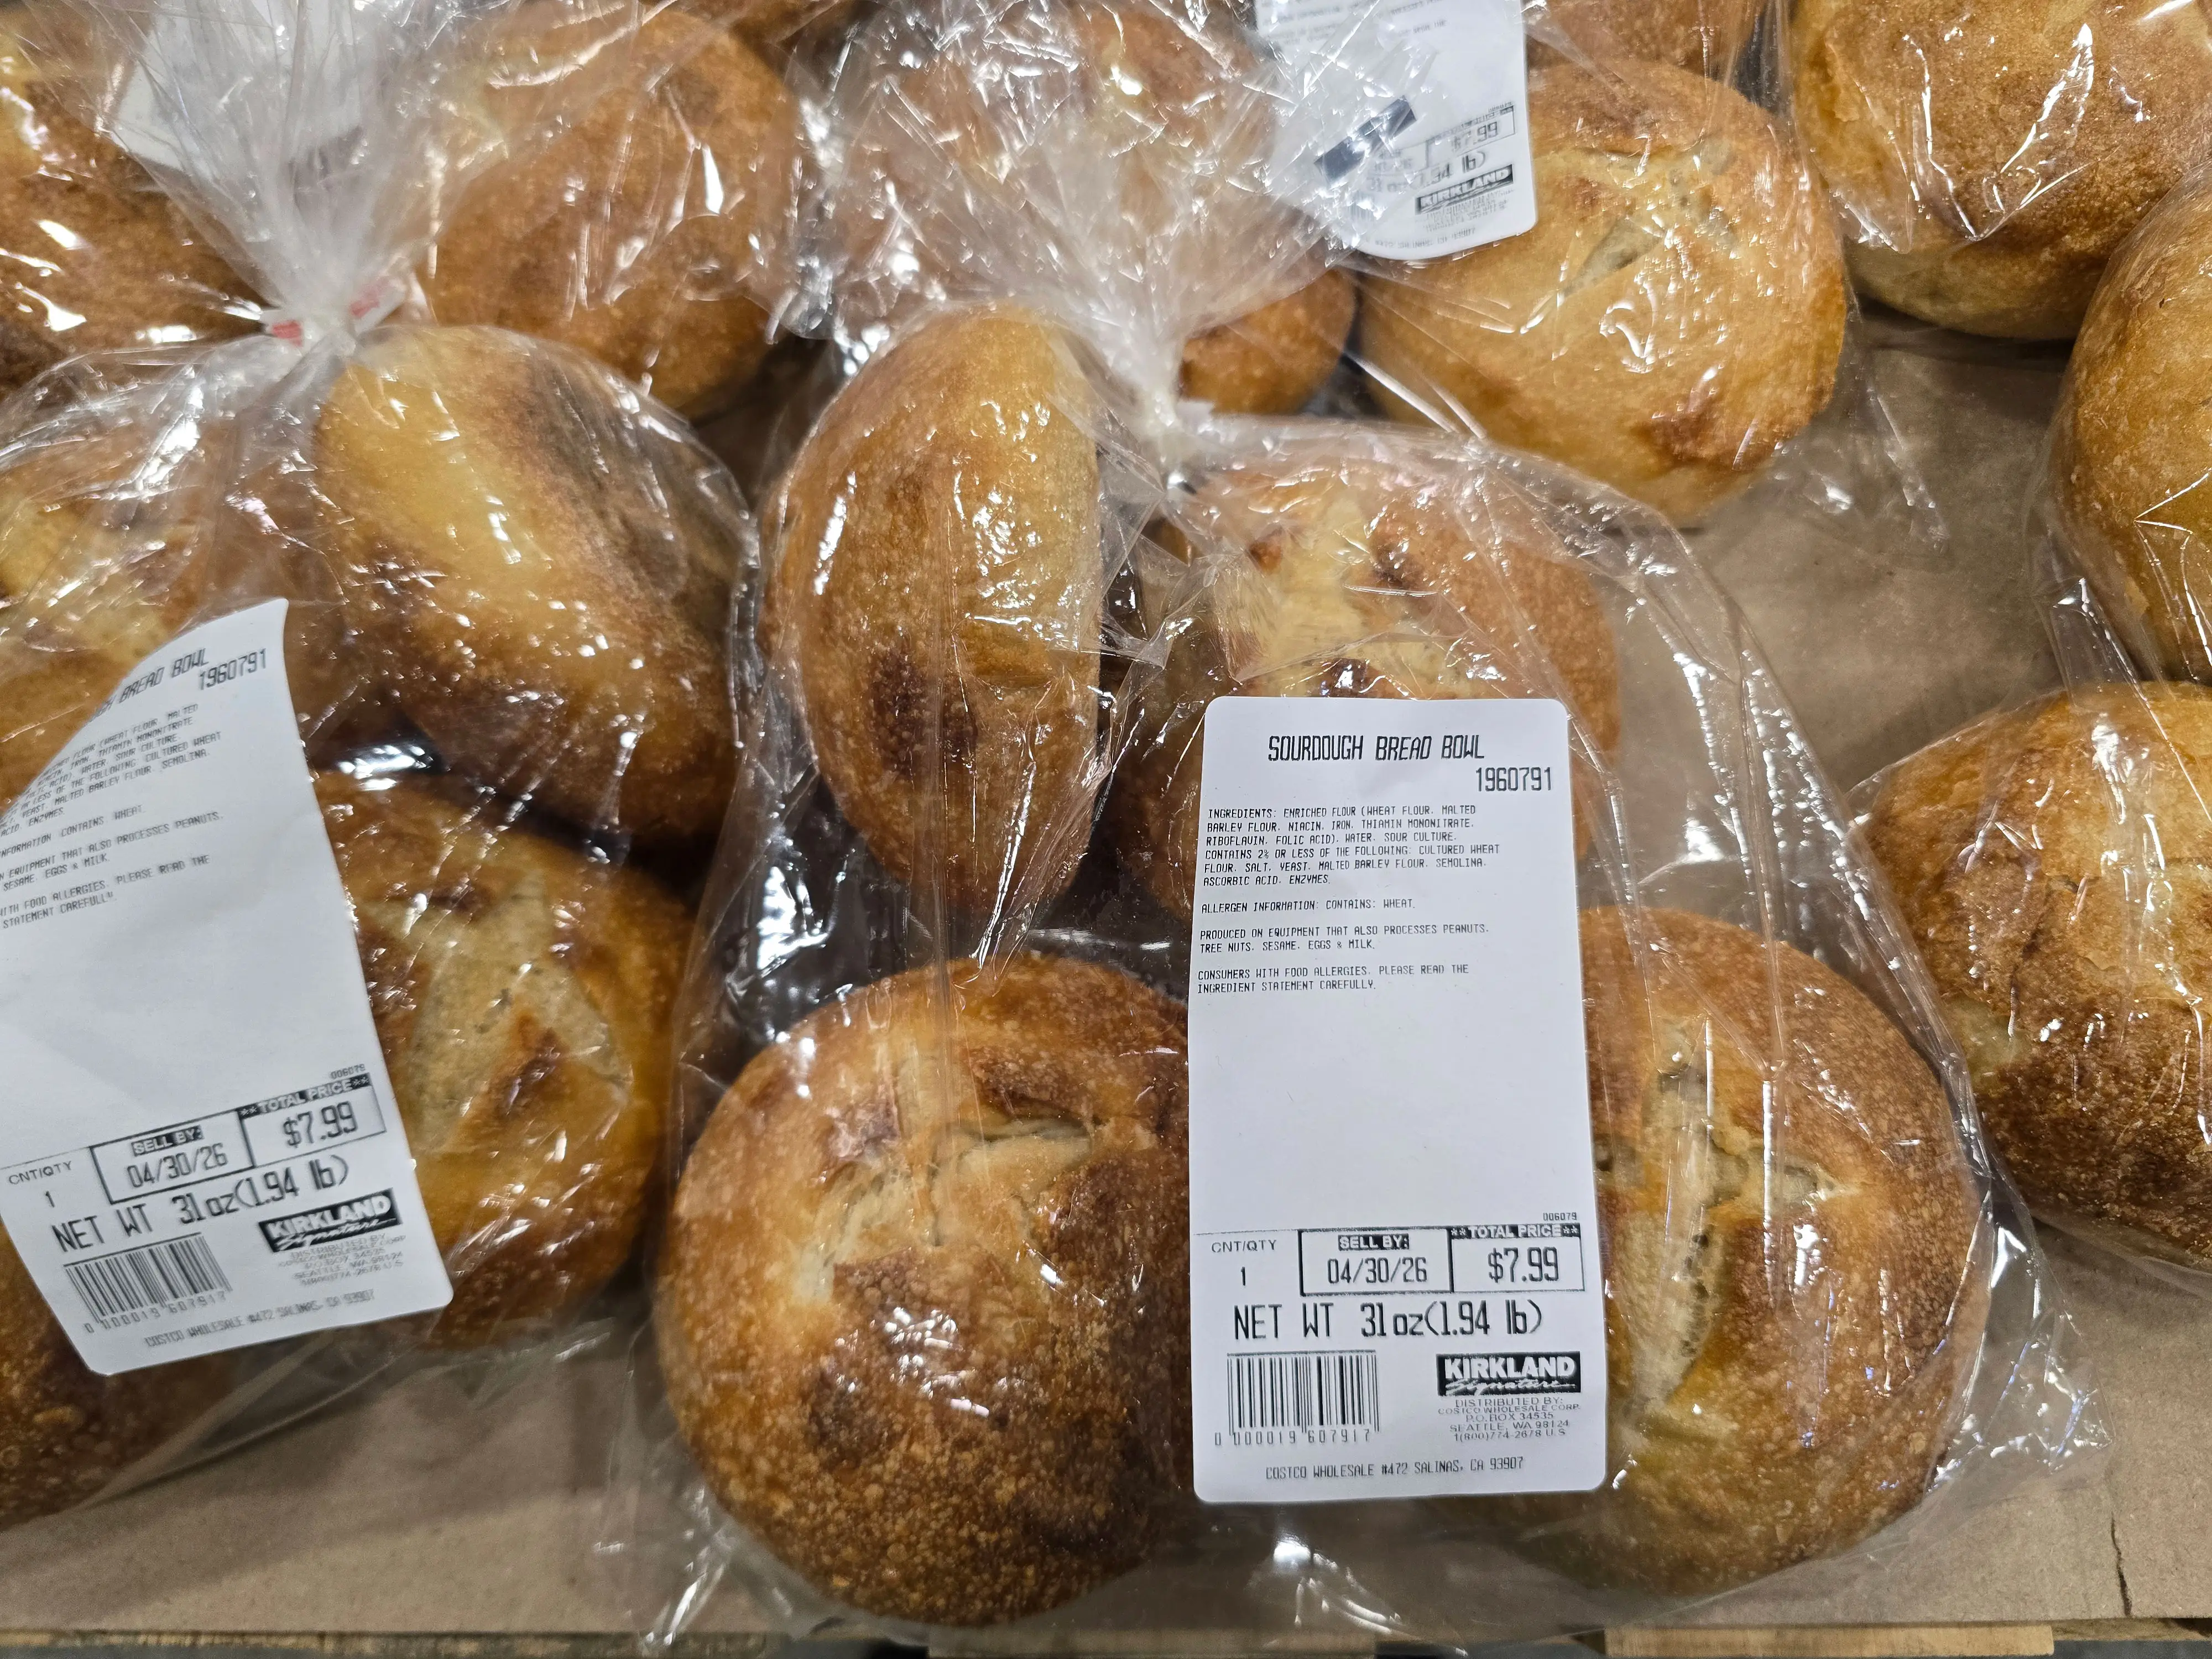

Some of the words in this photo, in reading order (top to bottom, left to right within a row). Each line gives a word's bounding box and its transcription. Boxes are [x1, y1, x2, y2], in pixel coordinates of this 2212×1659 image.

[1420, 168, 1511, 207] KIRKLAND
[170, 648, 209, 679] BOWL
[199, 648, 266, 690] 1960791
[1268, 735, 1364, 761] SOURDOUGH
[1375, 735, 1432, 761] BREAD
[1441, 734, 1485, 759] BOWL
[1475, 766, 1551, 792] 1960791
[1208, 807, 1276, 819] INGREDIENTS:
[1284, 807, 1327, 818] ENRICHED
[1332, 806, 1356, 817] FLOUR
[1361, 806, 1396, 817] (WHEAT
[1442, 805, 1475, 815] MALTED
[1207, 821, 1243, 833] BARLEY
[1361, 819, 1402, 829] THIAMIN
[1276, 835, 1305, 846] FOLIC
[1384, 832, 1407, 842] SOUR
[1205, 848, 1252, 860] CONTAINS
[1258, 849, 1269, 859] 2%
[1275, 849, 1286, 859] OR
[1292, 848, 1314, 858] LESS
[1319, 847, 1331, 858] OF
[1336, 847, 1350, 857] THE
[1355, 846, 1411, 856] FOLLOWING:
[1419, 844, 1464, 855] CULTURED
[1470, 844, 1499, 854] WHEAT
[1318, 860, 1350, 871] MALTED
[1354, 859, 1390, 869] BARLEY
[1203, 876, 1250, 887] ASCORBIC
[1289, 874, 1331, 884] ENZYMES.
[1201, 902, 1248, 915] ALLERGEN
[1253, 900, 1318, 912] INFORMATION:
[1326, 899, 1375, 910] CONTAINS:
[1383, 899, 1415, 908] WHEAT.
[1200, 927, 1246, 941] PRODUCED
[1251, 928, 1263, 938] ON
[1269, 926, 1320, 937] EQUIPMENT
[1326, 926, 1348, 936] THAT
[1354, 926, 1378, 936] ALSO
[1384, 925, 1437, 935] PROCESSES
[1200, 943, 1222, 954] TREE
[1308, 940, 1331, 950] EGGS
[1349, 939, 1375, 949] MILK.
[1198, 967, 1250, 980] CONSUMERS
[1256, 967, 1279, 978] WITH
[1285, 967, 1308, 978] FOOD
[1379, 965, 1413, 975] PLEASE
[1421, 964, 1444, 974] READ
[1452, 964, 1468, 973] THE
[1198, 982, 1256, 995] INGREDIENT
[1261, 980, 1313, 992] STATEMENT
[1319, 979, 1376, 989] CAREFULLY.
[283, 1100, 358, 1148] $7.99
[132, 1135, 174, 1156] SELL
[8, 1161, 71, 1185] CNT/QTY
[126, 1142, 228, 1188] 04/30/26
[51, 1215, 105, 1253] NET
[116, 1203, 153, 1237] WT
[308, 1154, 348, 1191] lb)
[267, 1194, 392, 1239] KIRKLAND
[1543, 1212, 1577, 1222] 006079
[1212, 1239, 1277, 1253] CNT/QTY
[1339, 1237, 1379, 1250] SELL
[1383, 1235, 1408, 1249] BY:
[1327, 1257, 1427, 1284] 04/30/26
[1488, 1246, 1559, 1284] $7.99
[1240, 1266, 1246, 1286] 1
[1234, 1304, 1282, 1340] NET
[1302, 1302, 1334, 1338] WT
[1444, 1356, 1575, 1379] KIRKLAND
[1266, 1465, 1307, 1480] COSTCO
[1313, 1463, 1374, 1478] WHOLESALE
[1381, 1462, 1408, 1475] #472
[1470, 1458, 1484, 1471] CA
[1490, 1456, 1524, 1470] 93907
